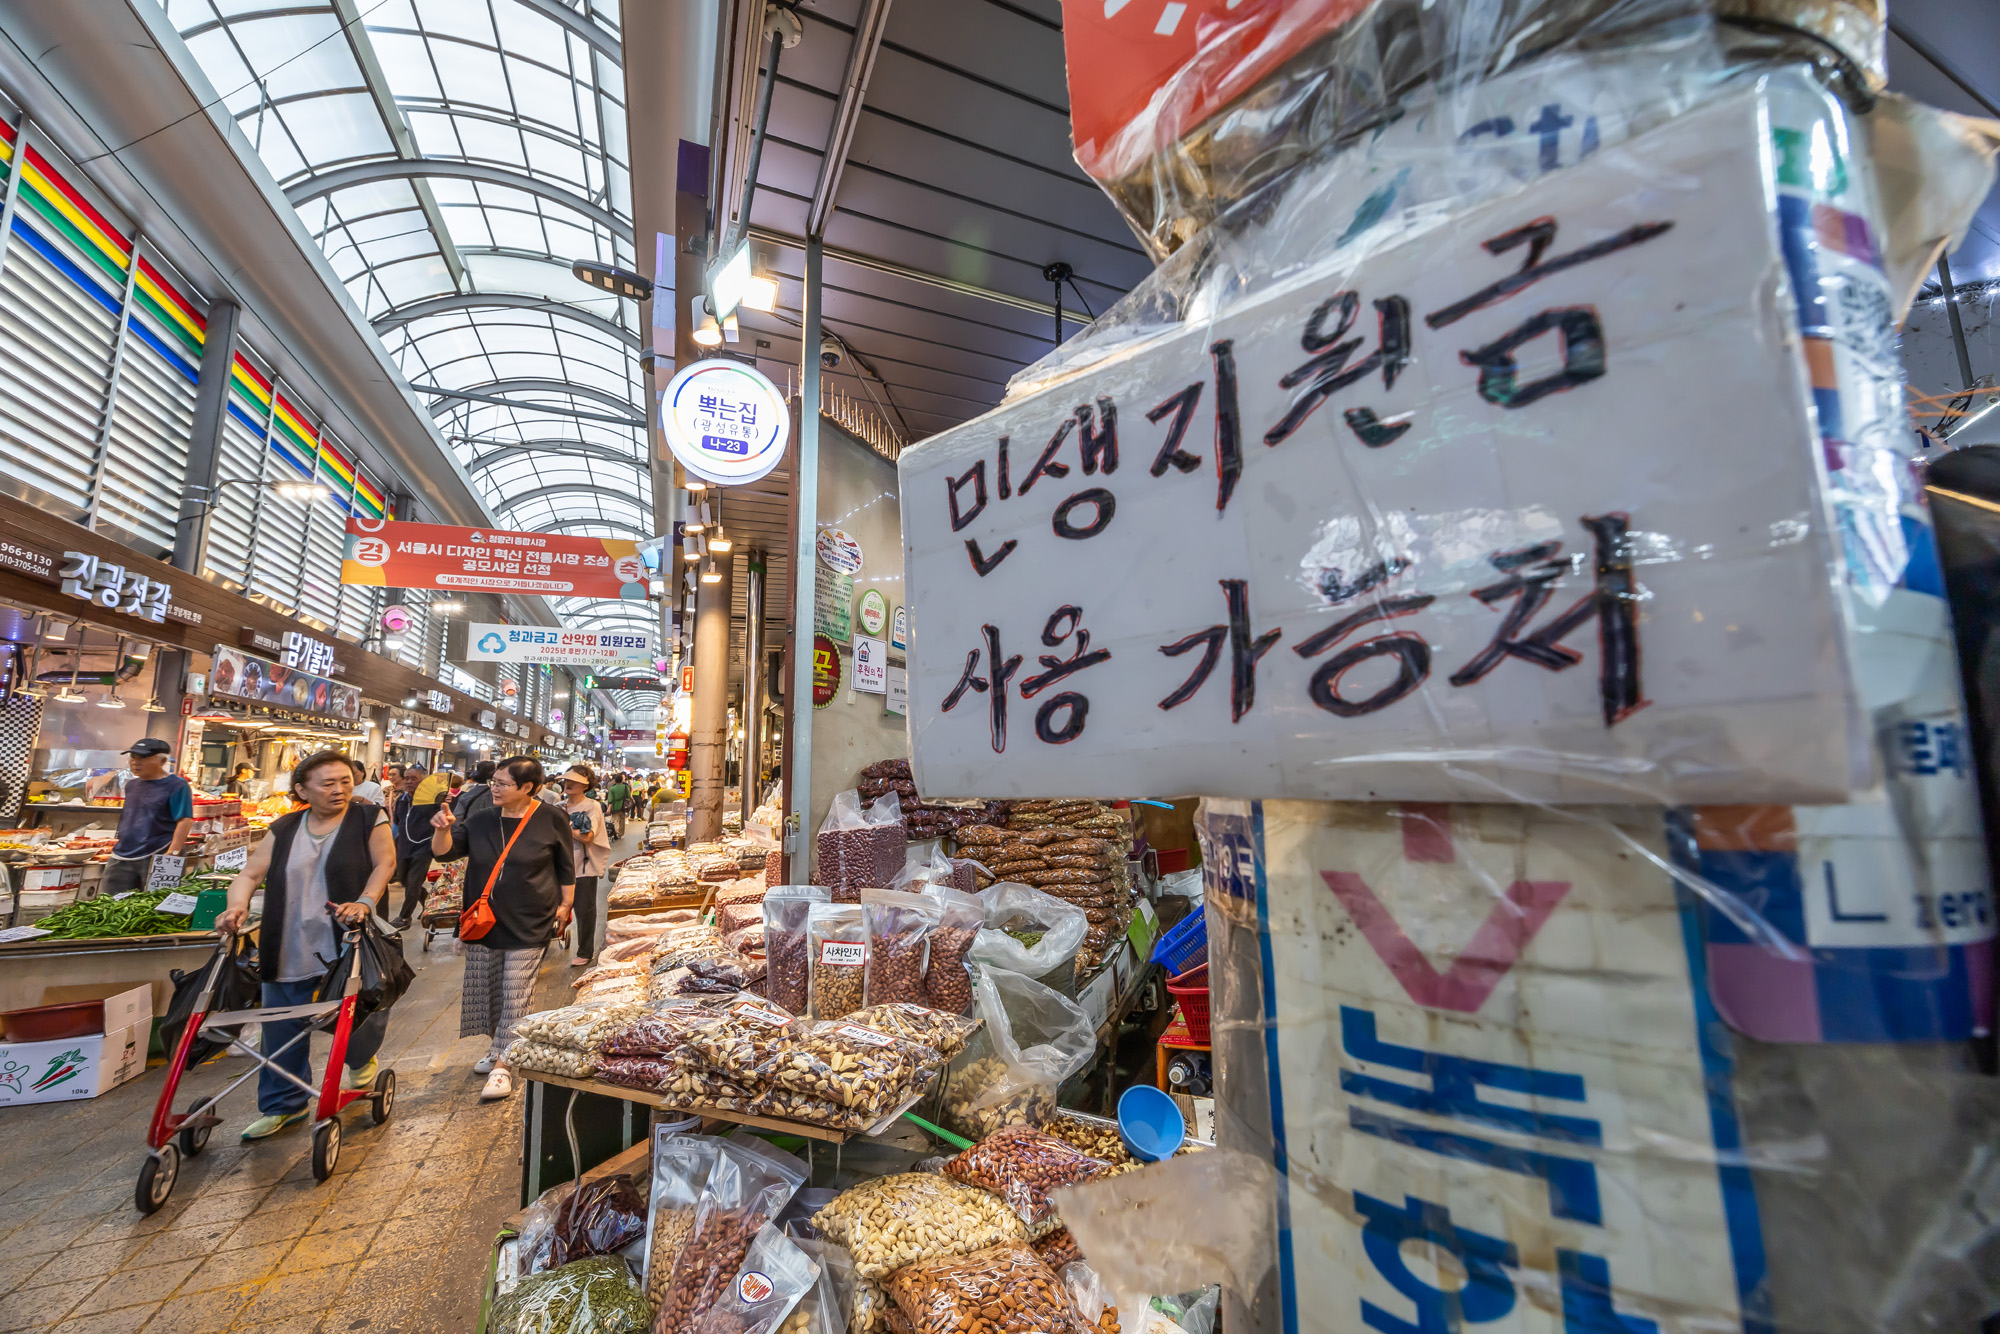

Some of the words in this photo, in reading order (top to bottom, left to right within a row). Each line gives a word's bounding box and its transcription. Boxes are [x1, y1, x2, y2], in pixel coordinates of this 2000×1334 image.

[945, 214, 1676, 577] 민생지원금
[710, 437, 741, 452] 나-23
[489, 534, 514, 546] 청량리
[515, 536, 547, 548] 종합시장
[358, 541, 384, 562] 경
[396, 541, 442, 556] 서울시
[446, 545, 490, 559] 디자인
[494, 548, 522, 562] 혁신
[526, 550, 580, 565] 전통시장
[583, 555, 610, 567] 조성
[463, 559, 520, 574] 공모사업
[523, 563, 551, 576] 선정
[619, 560, 639, 579] 축
[59, 551, 172, 624] 진광젓갈
[508, 630, 558, 644] 청과금고
[561, 633, 597, 646] 산악회
[600, 635, 646, 649] 회원모집
[940, 603, 1113, 755] 사용
[1156, 511, 1654, 728] 가능처
[540, 646, 567, 655] 2025년
[856, 663, 876, 677] 후원의
[876, 666, 884, 678] 집
[825, 946, 862, 958] 사차인지
